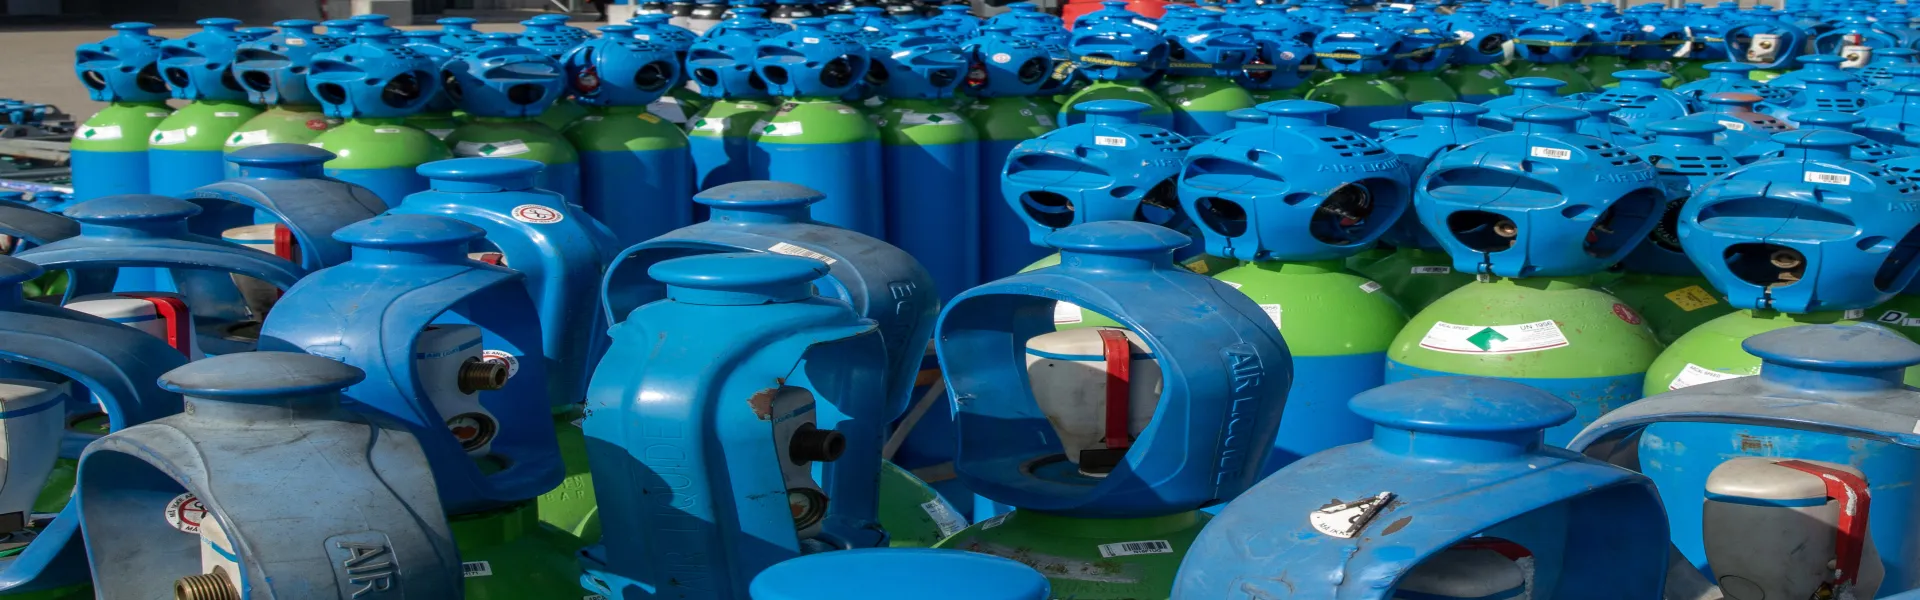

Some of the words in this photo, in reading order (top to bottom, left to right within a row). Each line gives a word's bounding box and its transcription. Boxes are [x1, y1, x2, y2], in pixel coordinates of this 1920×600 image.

[1317, 163, 1357, 173] AIR
[1226, 351, 1261, 393] AIR
[336, 541, 392, 600] AIR
